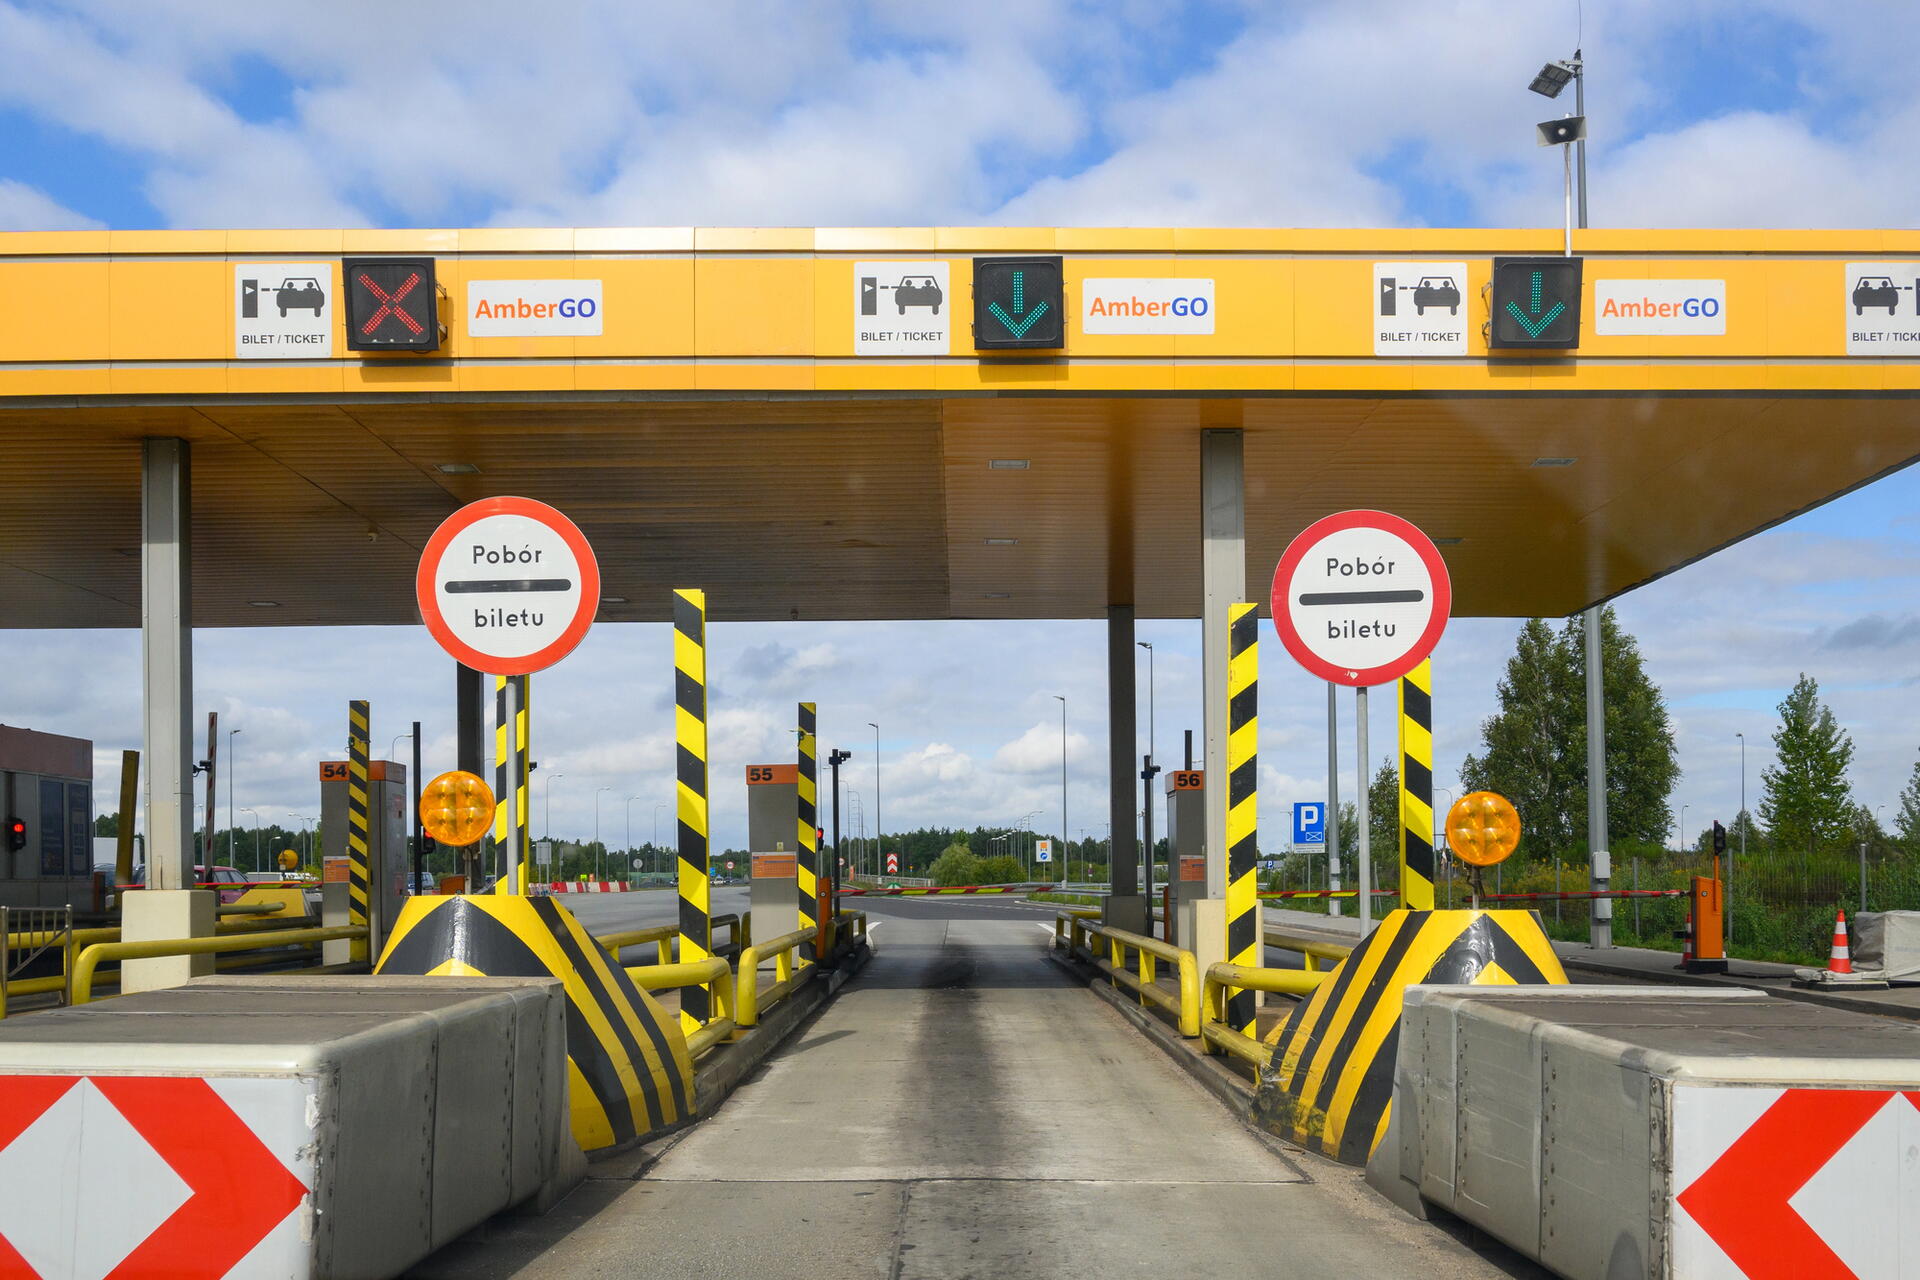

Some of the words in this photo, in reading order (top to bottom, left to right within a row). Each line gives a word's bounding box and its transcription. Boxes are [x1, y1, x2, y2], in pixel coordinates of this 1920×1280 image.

[475, 297, 596, 319] AmberGO
[1089, 295, 1209, 317] AmberGO
[1601, 295, 1720, 318] AmberGO
[241, 334, 275, 345] BILET
[277, 334, 282, 345] /
[284, 334, 326, 345] TICKET
[860, 331, 894, 342] BILET
[896, 331, 900, 342] /
[902, 331, 943, 342] TICKET
[1380, 331, 1413, 342] BILET
[1415, 331, 1419, 342] /
[1421, 331, 1461, 342] TICKET
[1852, 332, 1884, 342] BILET
[1886, 332, 1890, 342] /
[1893, 332, 1920, 342] TICK
[472, 544, 543, 565] Pobór
[1326, 556, 1396, 577] Pobór
[474, 608, 545, 628] biletu
[1327, 619, 1396, 639] biletu
[323, 764, 347, 778] 54
[750, 767, 773, 782] 55
[1177, 773, 1201, 787] 56
[1300, 805, 1319, 832] P
